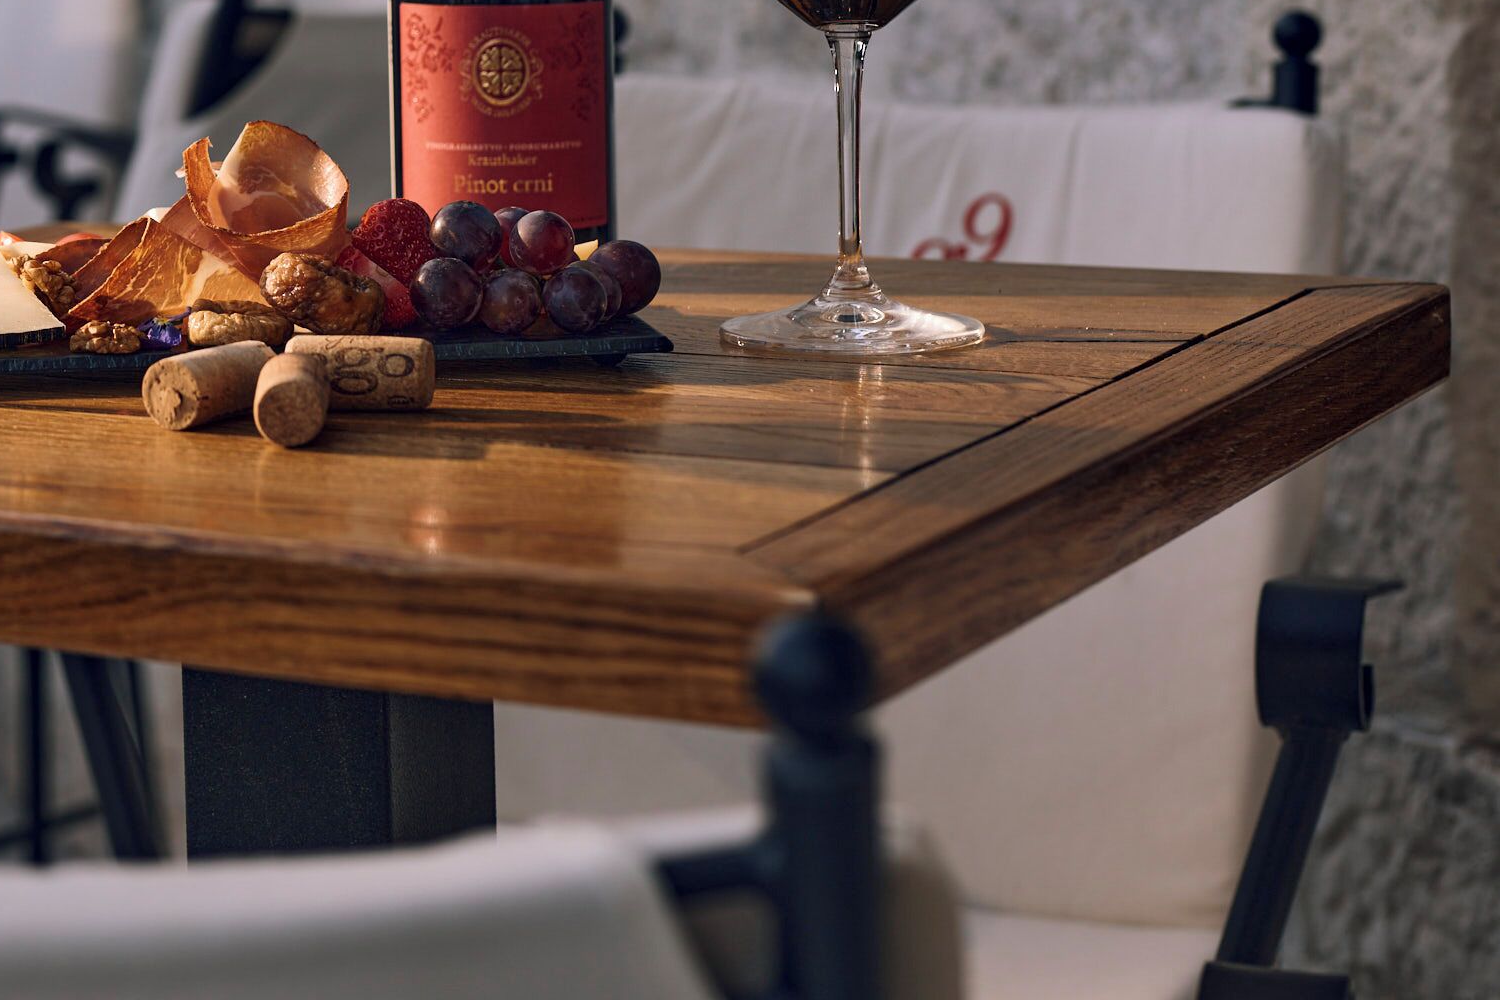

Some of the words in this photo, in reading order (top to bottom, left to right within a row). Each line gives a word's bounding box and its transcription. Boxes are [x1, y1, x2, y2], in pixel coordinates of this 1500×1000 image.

[467, 153, 538, 167] Krauthaker
[453, 173, 507, 195] Pinot
[512, 172, 554, 194] crni
